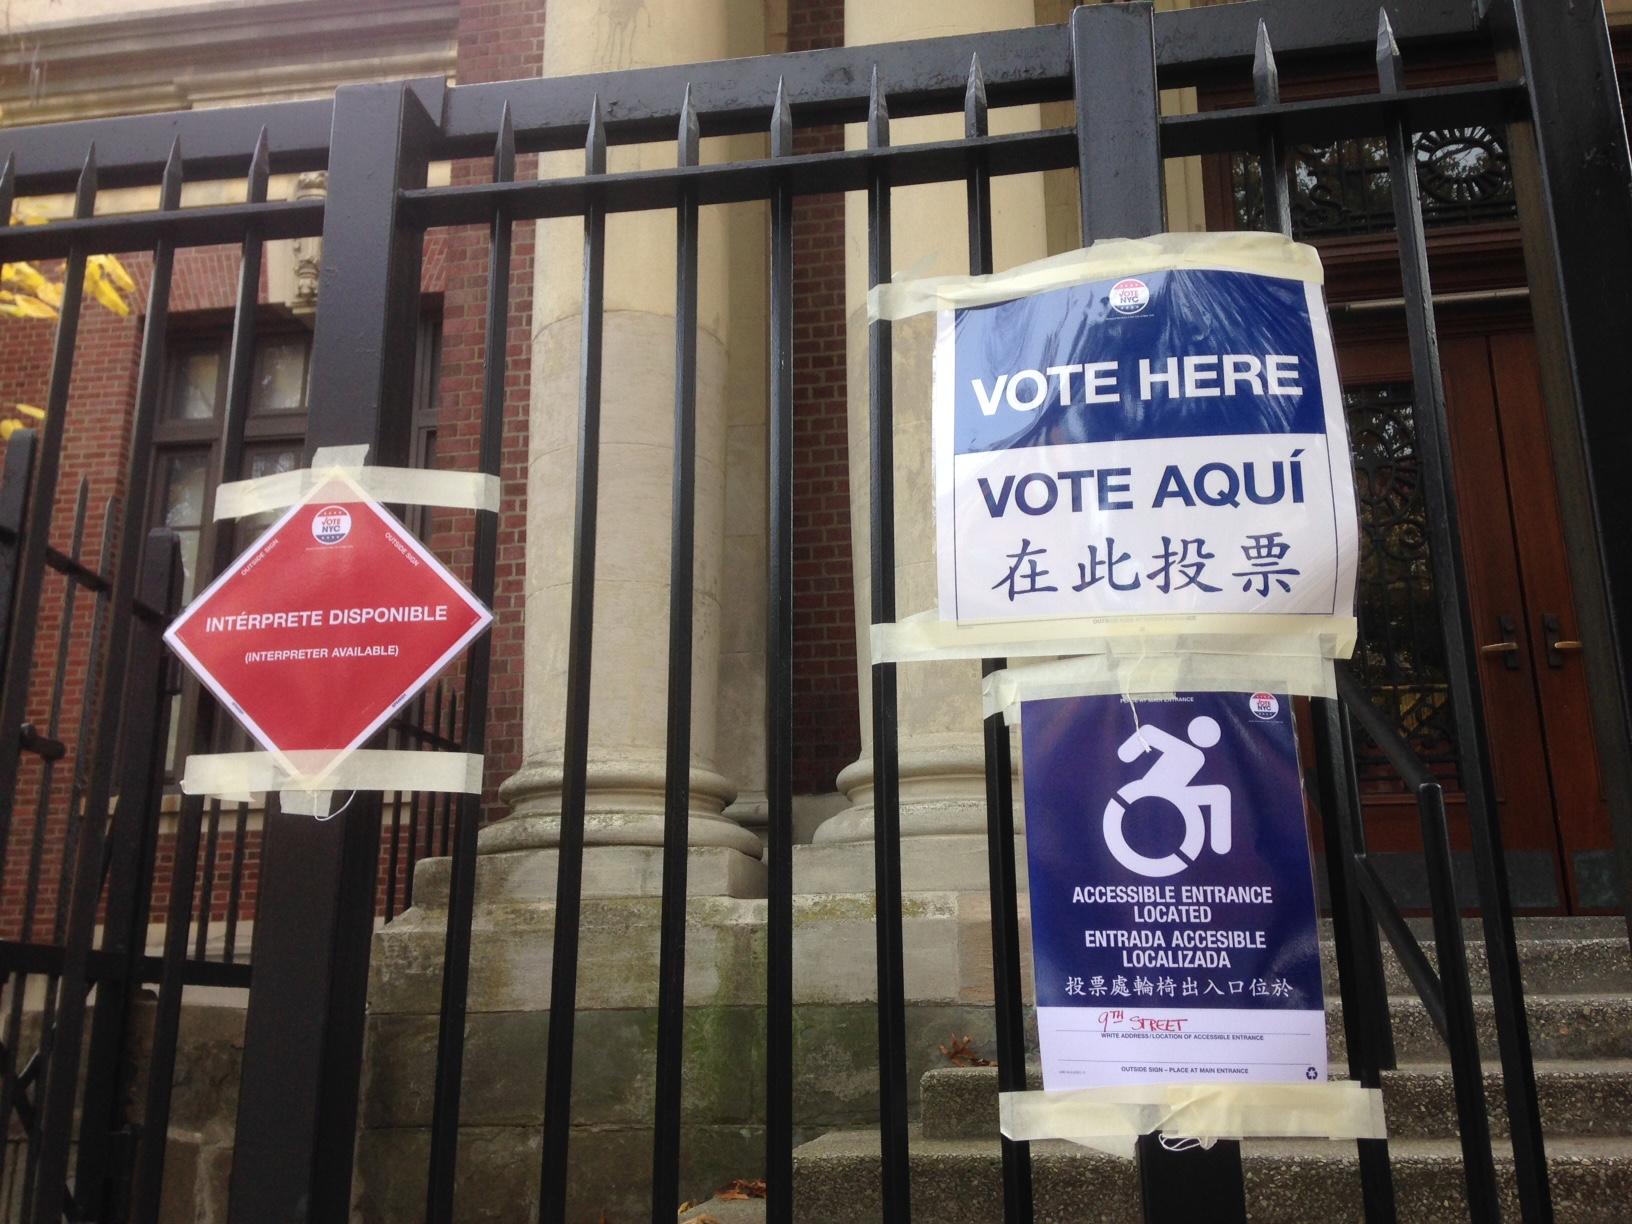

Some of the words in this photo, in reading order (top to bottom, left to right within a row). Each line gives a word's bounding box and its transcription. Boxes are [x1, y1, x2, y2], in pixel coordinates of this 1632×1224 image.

[1119, 289, 1137, 297] VOTE
[971, 361, 1120, 416] VOTE
[1139, 354, 1303, 400] HERE
[977, 467, 1133, 519] VOTE
[1151, 448, 1305, 509] AQUÍ
[321, 518, 341, 526] VOTE
[241, 552, 265, 576] OUTSIDE
[264, 538, 279, 553] SIGN
[384, 532, 408, 556] OUTSIDE
[405, 552, 419, 567] SIGN
[991, 531, 1301, 602] 在此投票
[205, 611, 323, 632] INTÉRPRETE
[329, 605, 447, 625] DISPONIBLE
[245, 648, 328, 664] (INTERPRETER
[331, 645, 399, 658] AVAILABLE)
[1072, 886, 1175, 903] ACCESSIBLE
[1181, 886, 1273, 903] ENTRANCE
[1134, 906, 1212, 923] LOCATED
[1085, 930, 1166, 947] ENTRADA
[1171, 931, 1266, 948] ACCESIBLE
[1122, 950, 1231, 968] LOCALIZADA
[1065, 975, 1293, 997] 投票處輪椅出入口位於
[1098, 1010, 1124, 1032] 9TH
[1129, 1016, 1188, 1031] STREET
